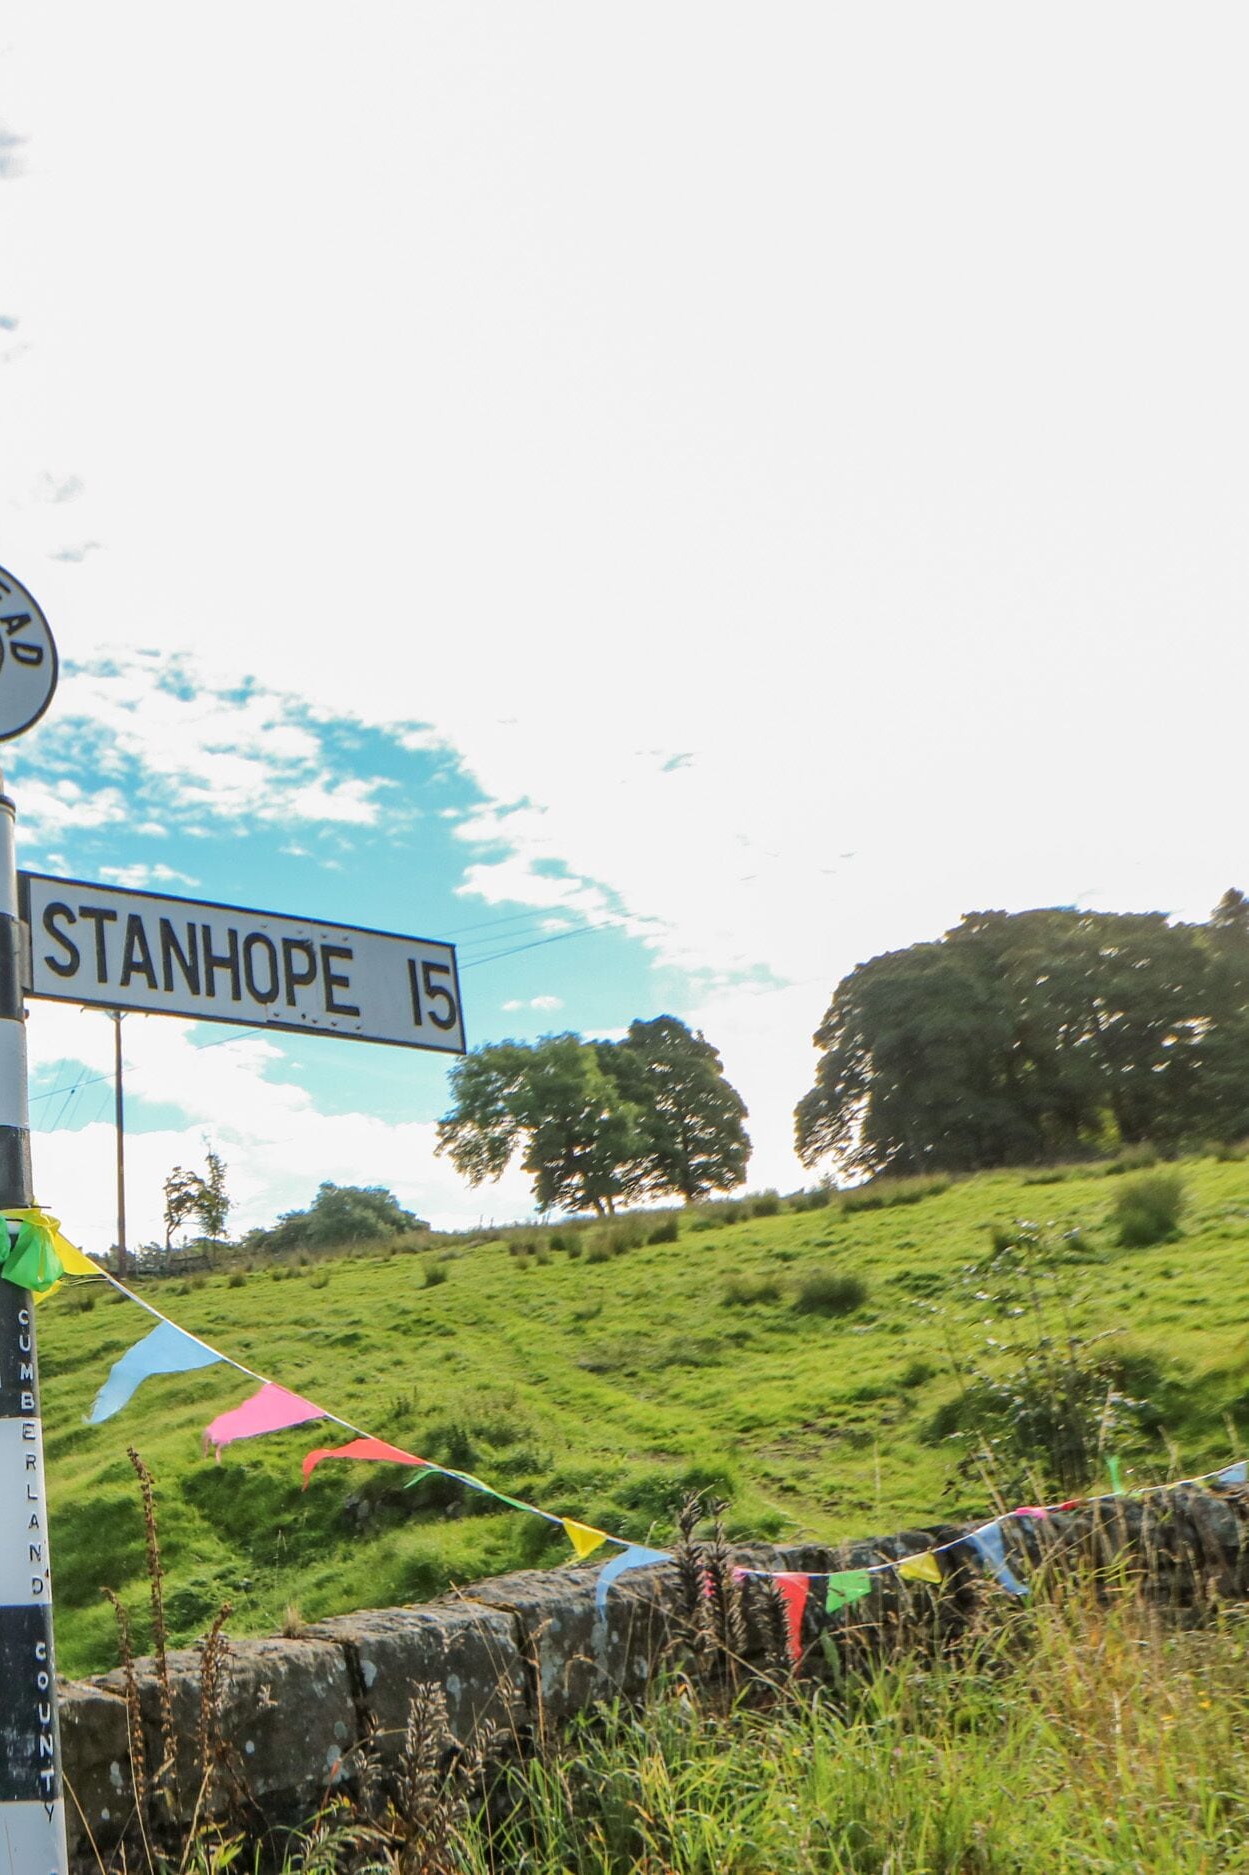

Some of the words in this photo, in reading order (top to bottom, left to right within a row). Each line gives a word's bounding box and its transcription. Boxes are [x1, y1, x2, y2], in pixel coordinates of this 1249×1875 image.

[43, 902, 361, 1017] STANHOPE
[407, 958, 457, 1031] 15
[18, 1309, 44, 1596] CUMBERLAND
[35, 1642, 55, 1823] COUNTY
